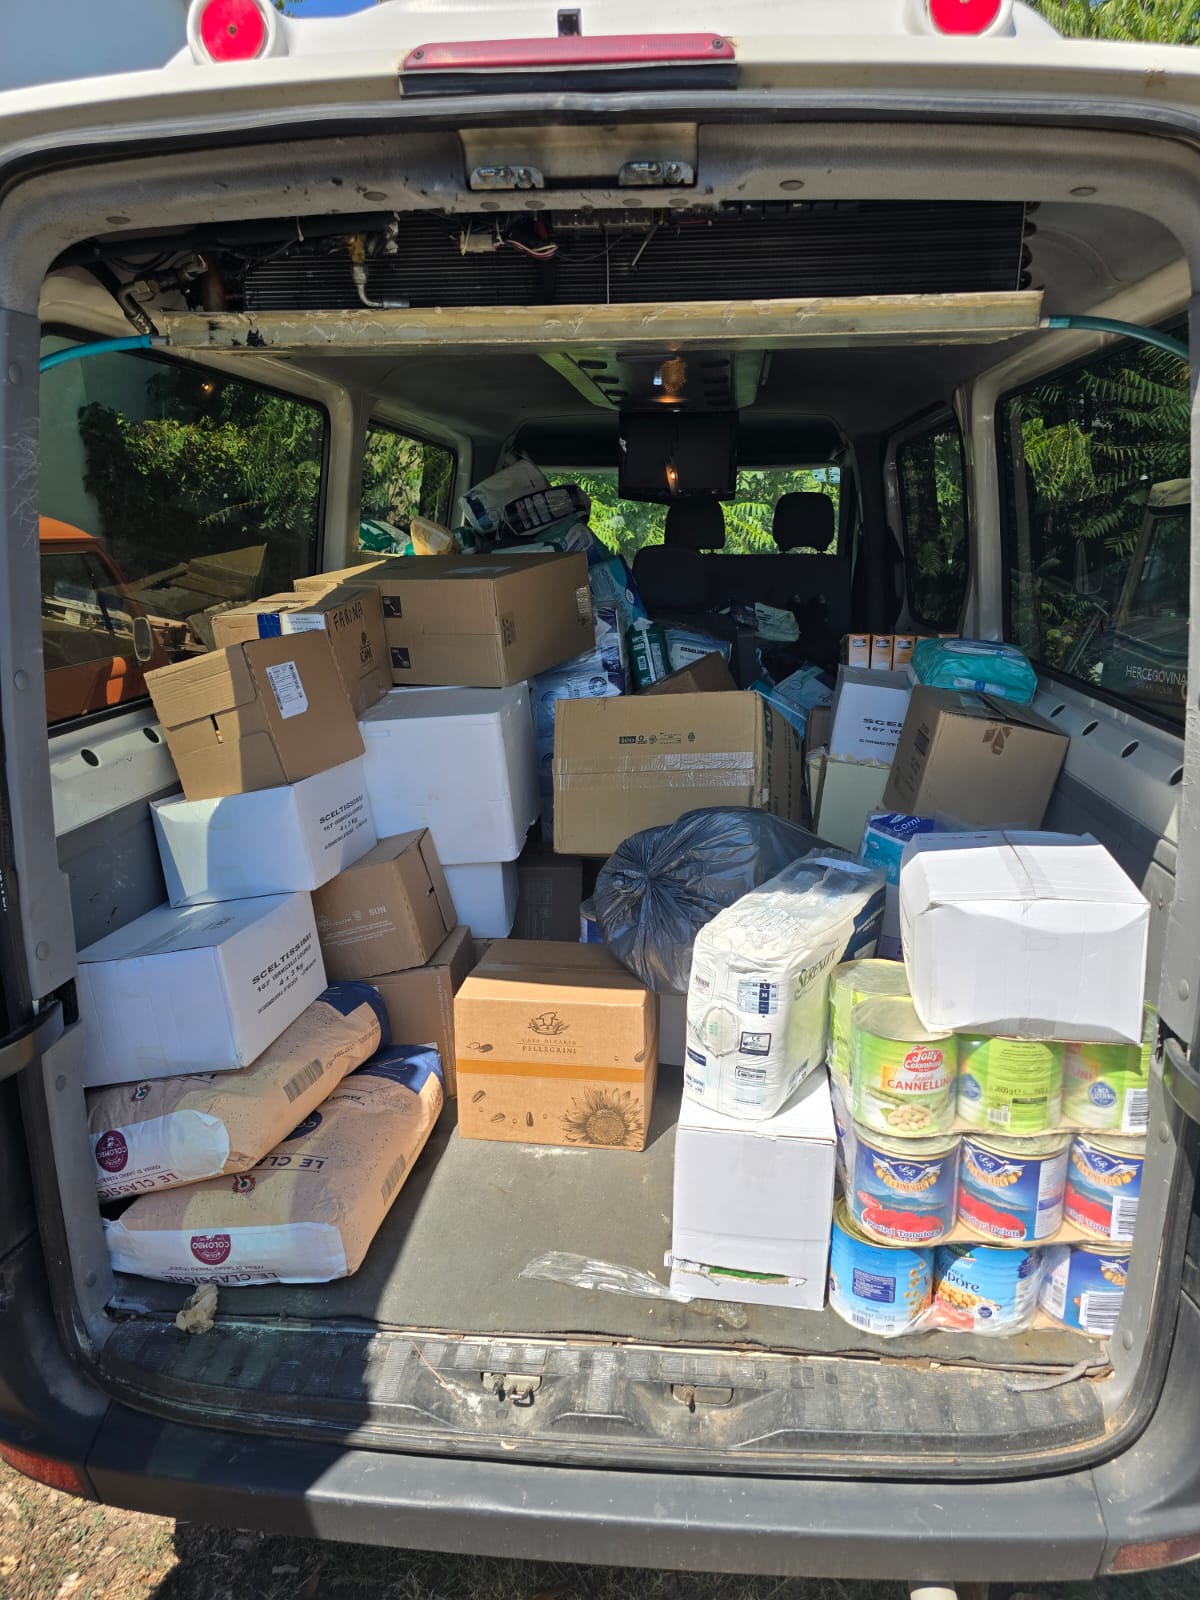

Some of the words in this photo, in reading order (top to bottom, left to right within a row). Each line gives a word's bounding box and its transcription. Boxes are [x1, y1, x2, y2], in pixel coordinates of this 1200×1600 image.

[333, 601, 363, 632] FARINA
[1126, 664, 1186, 686] HERCEGOVINA
[252, 932, 312, 985] SCELTISSIMI
[522, 1044, 577, 1055] PELLEGRINI
[912, 1050, 938, 1063] Jolly
[96, 1146, 127, 1159] COLOMBO
[299, 1158, 325, 1170] LE
[157, 1172, 179, 1184] LE
[97, 1179, 156, 1199] CLASSIC
[866, 1218, 896, 1236] Peeled
[898, 1229, 942, 1238] Tomatoes
[191, 1241, 230, 1250] COLOMBO
